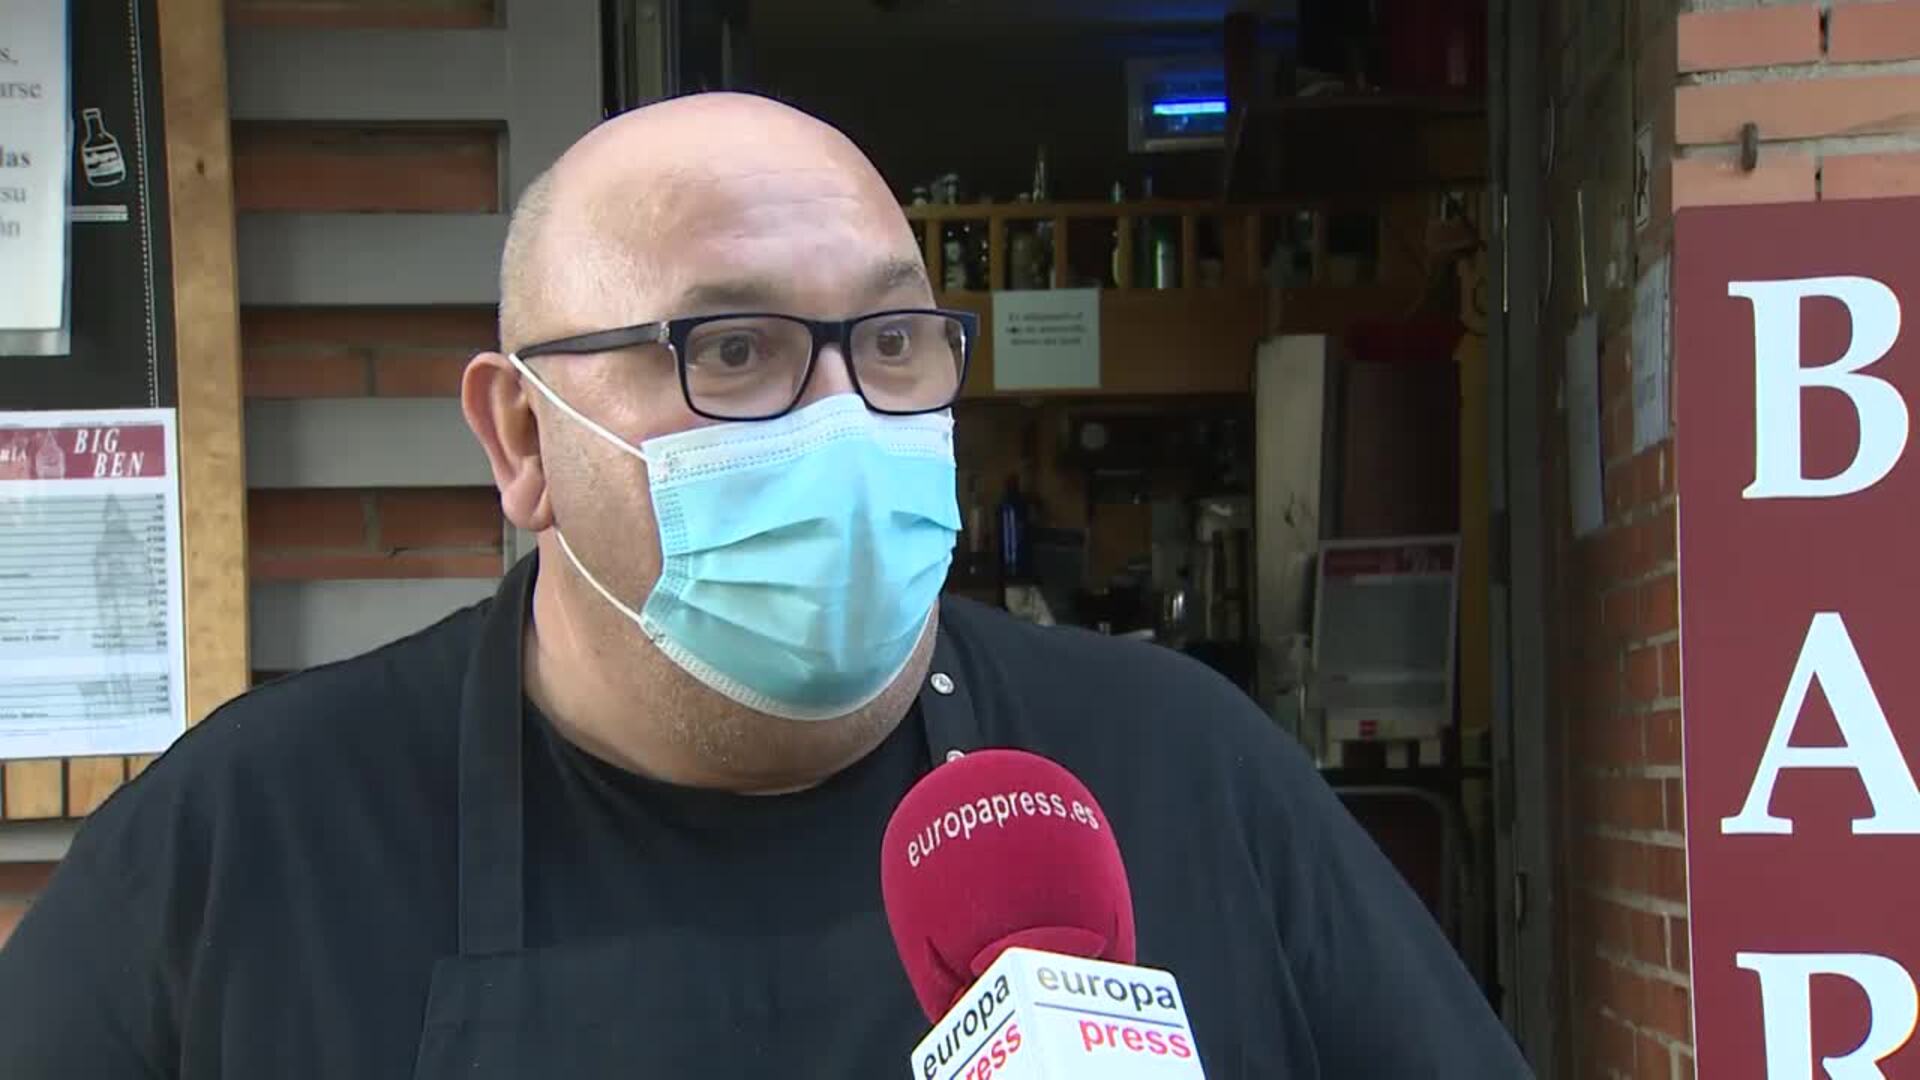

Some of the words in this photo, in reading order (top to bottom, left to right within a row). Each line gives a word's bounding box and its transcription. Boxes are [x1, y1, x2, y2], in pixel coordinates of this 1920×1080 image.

[74, 428, 120, 454] BIG
[94, 451, 145, 477] BEN
[1720, 275, 1920, 1080] BAR
[907, 791, 1099, 867] europapress.es
[1037, 966, 1177, 1011] europa
[923, 974, 1010, 1080] europa
[1078, 1019, 1192, 1059] press
